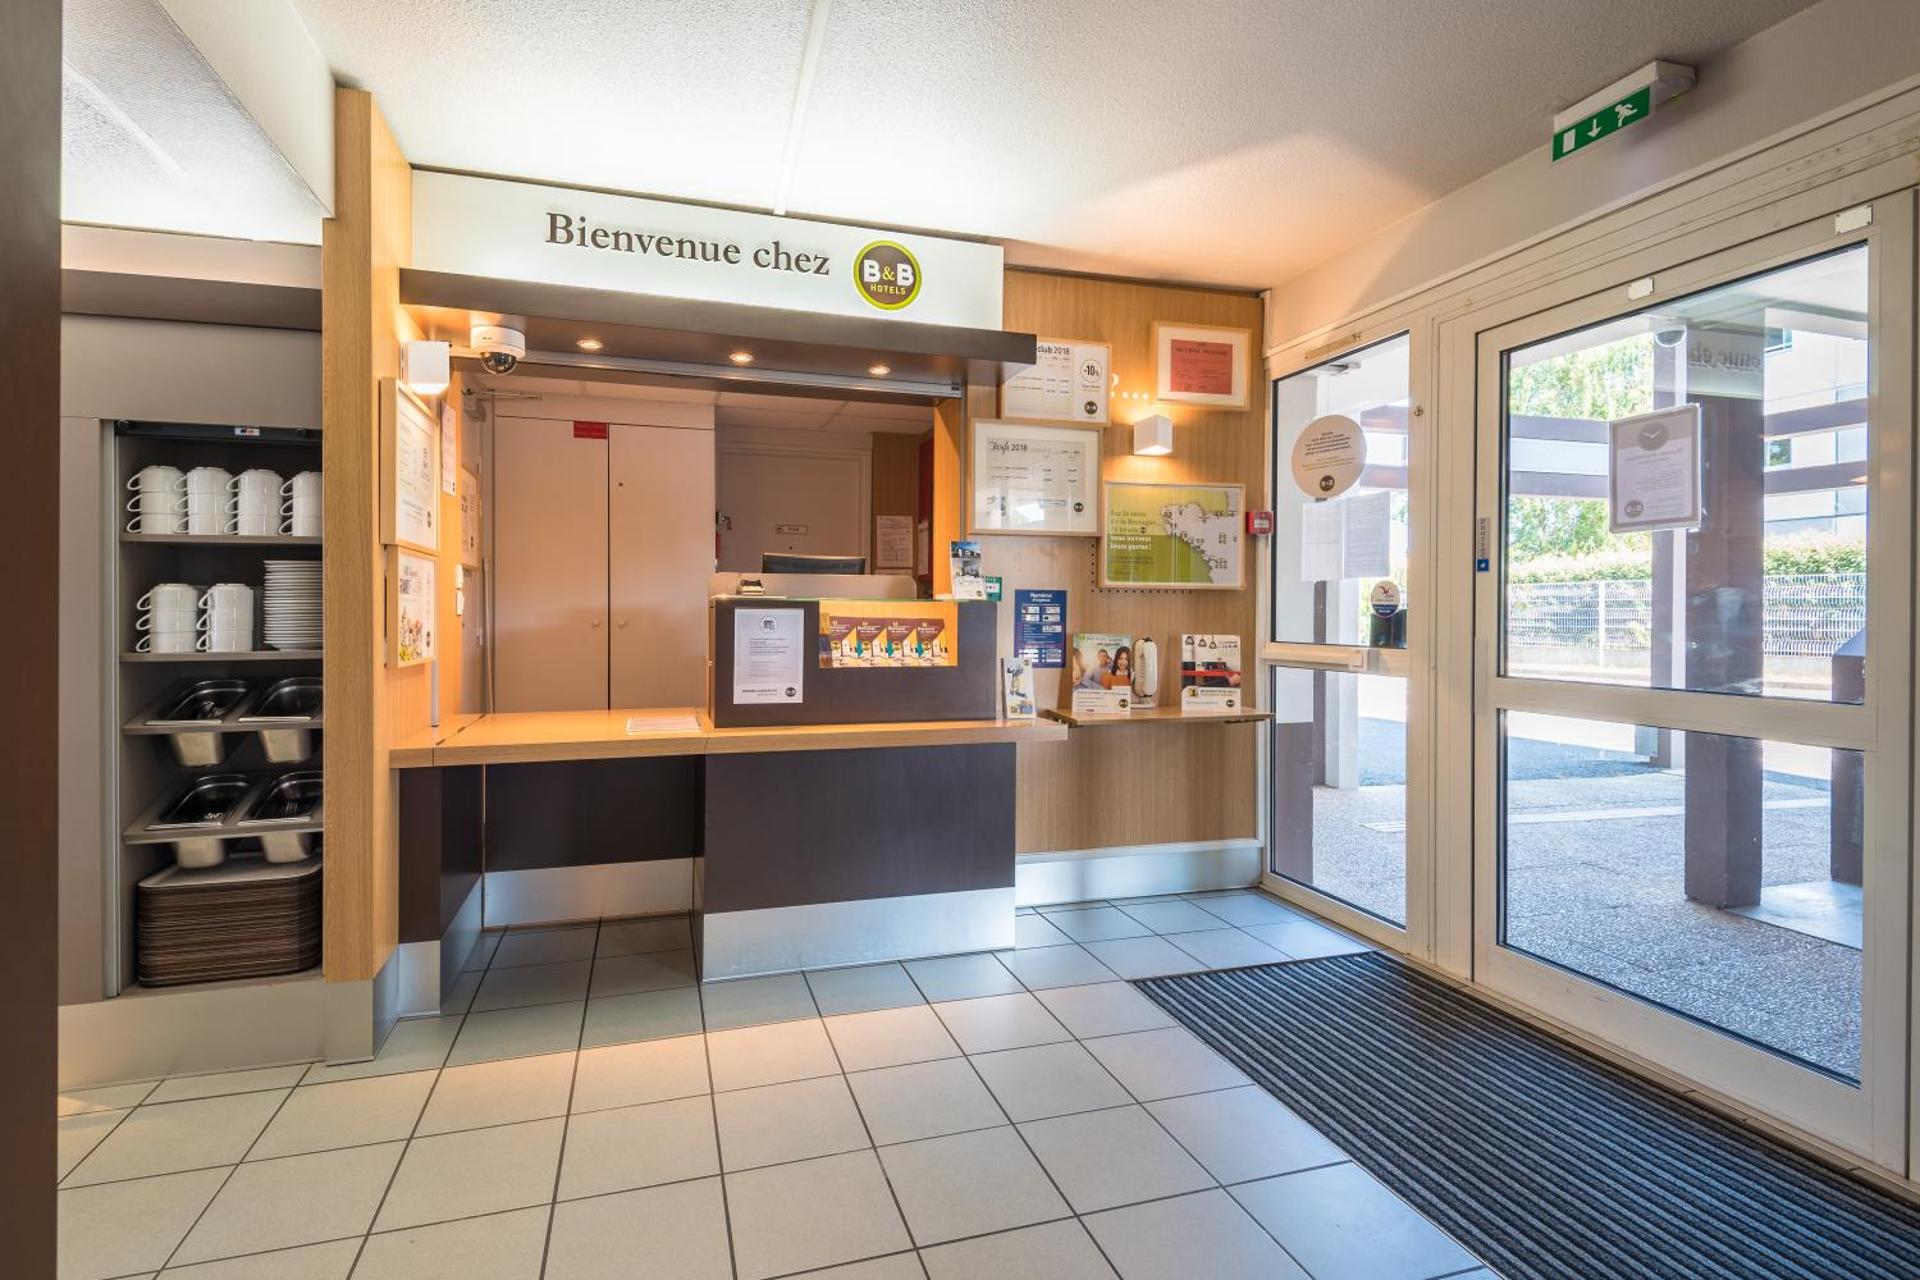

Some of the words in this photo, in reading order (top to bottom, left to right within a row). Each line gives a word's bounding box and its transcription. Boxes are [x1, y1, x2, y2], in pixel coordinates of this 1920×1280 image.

[545, 211, 741, 265] Bienvenue
[753, 240, 831, 276] chez
[863, 259, 915, 287] B&B
[870, 283, 906, 295] HOTELS
